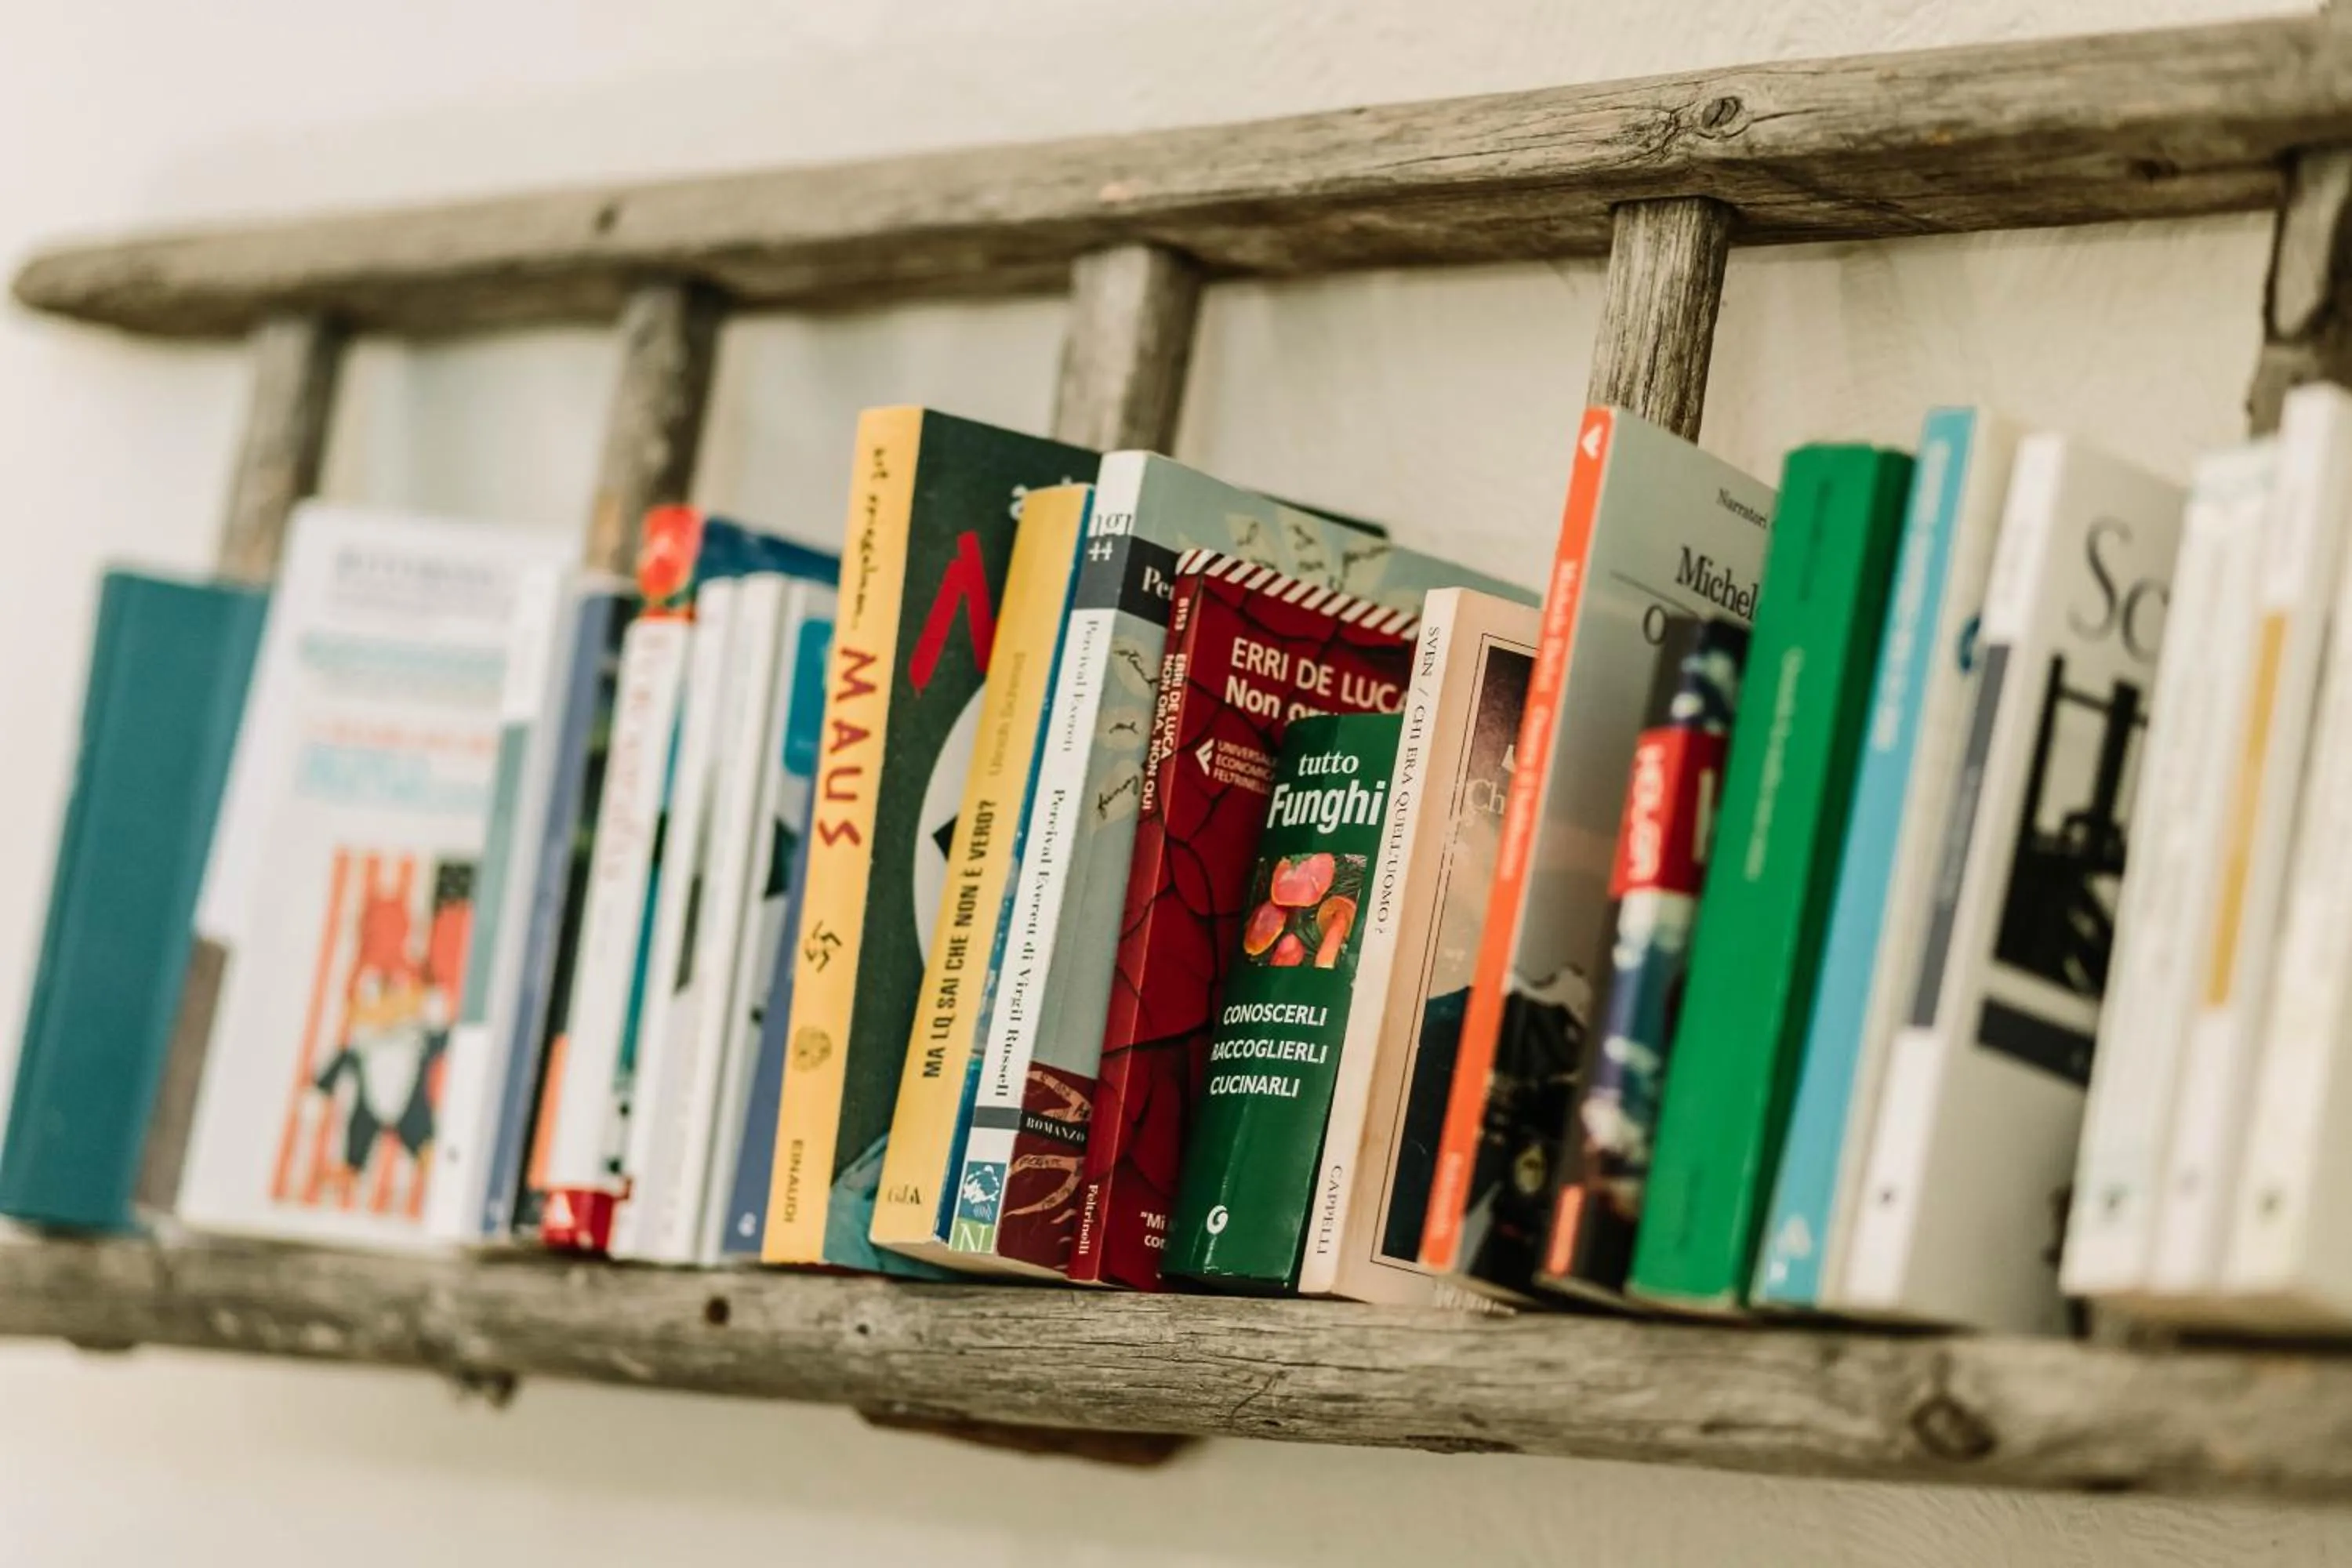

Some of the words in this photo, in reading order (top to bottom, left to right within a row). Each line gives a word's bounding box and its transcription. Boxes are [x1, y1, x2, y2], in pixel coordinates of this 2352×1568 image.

[1087, 539, 1113, 562] 44
[1675, 546, 1759, 622] Michel
[1231, 637, 1290, 682] ERRI
[1296, 659, 1336, 696] DE
[1421, 626, 1440, 677] SVEN
[1160, 654, 1175, 692] NON
[1171, 654, 1188, 689] ERRI
[1168, 691, 1182, 713] DE
[1225, 675, 1282, 719] Non
[1160, 717, 1178, 760] LUCA
[1410, 705, 1427, 740] CHI
[818, 646, 877, 847] MAUS
[1147, 739, 1163, 778] NON
[1298, 750, 1359, 777] tutto
[1402, 747, 1419, 785] ERA
[1142, 779, 1156, 811] QUI
[1266, 779, 1386, 835] Funghi
[969, 800, 997, 862] VERO?
[1041, 789, 1065, 863] Percival
[955, 884, 979, 927] NON
[946, 935, 968, 971] CHE
[1022, 942, 1036, 960] di
[938, 978, 960, 1009] SAI
[1010, 969, 1032, 1022] Virgil
[1223, 1004, 1328, 1026] CONOSCERLI
[923, 1047, 946, 1079] MA
[995, 1029, 1020, 1097] Russell
[1210, 1075, 1301, 1098] CUCINARLI
[1025, 1116, 1085, 1142] ROMANZO
[783, 1139, 804, 1224] EINAUDI
[1079, 1184, 1098, 1255] Feltrinelli
[1316, 1164, 1343, 1255] CAPPELLI
